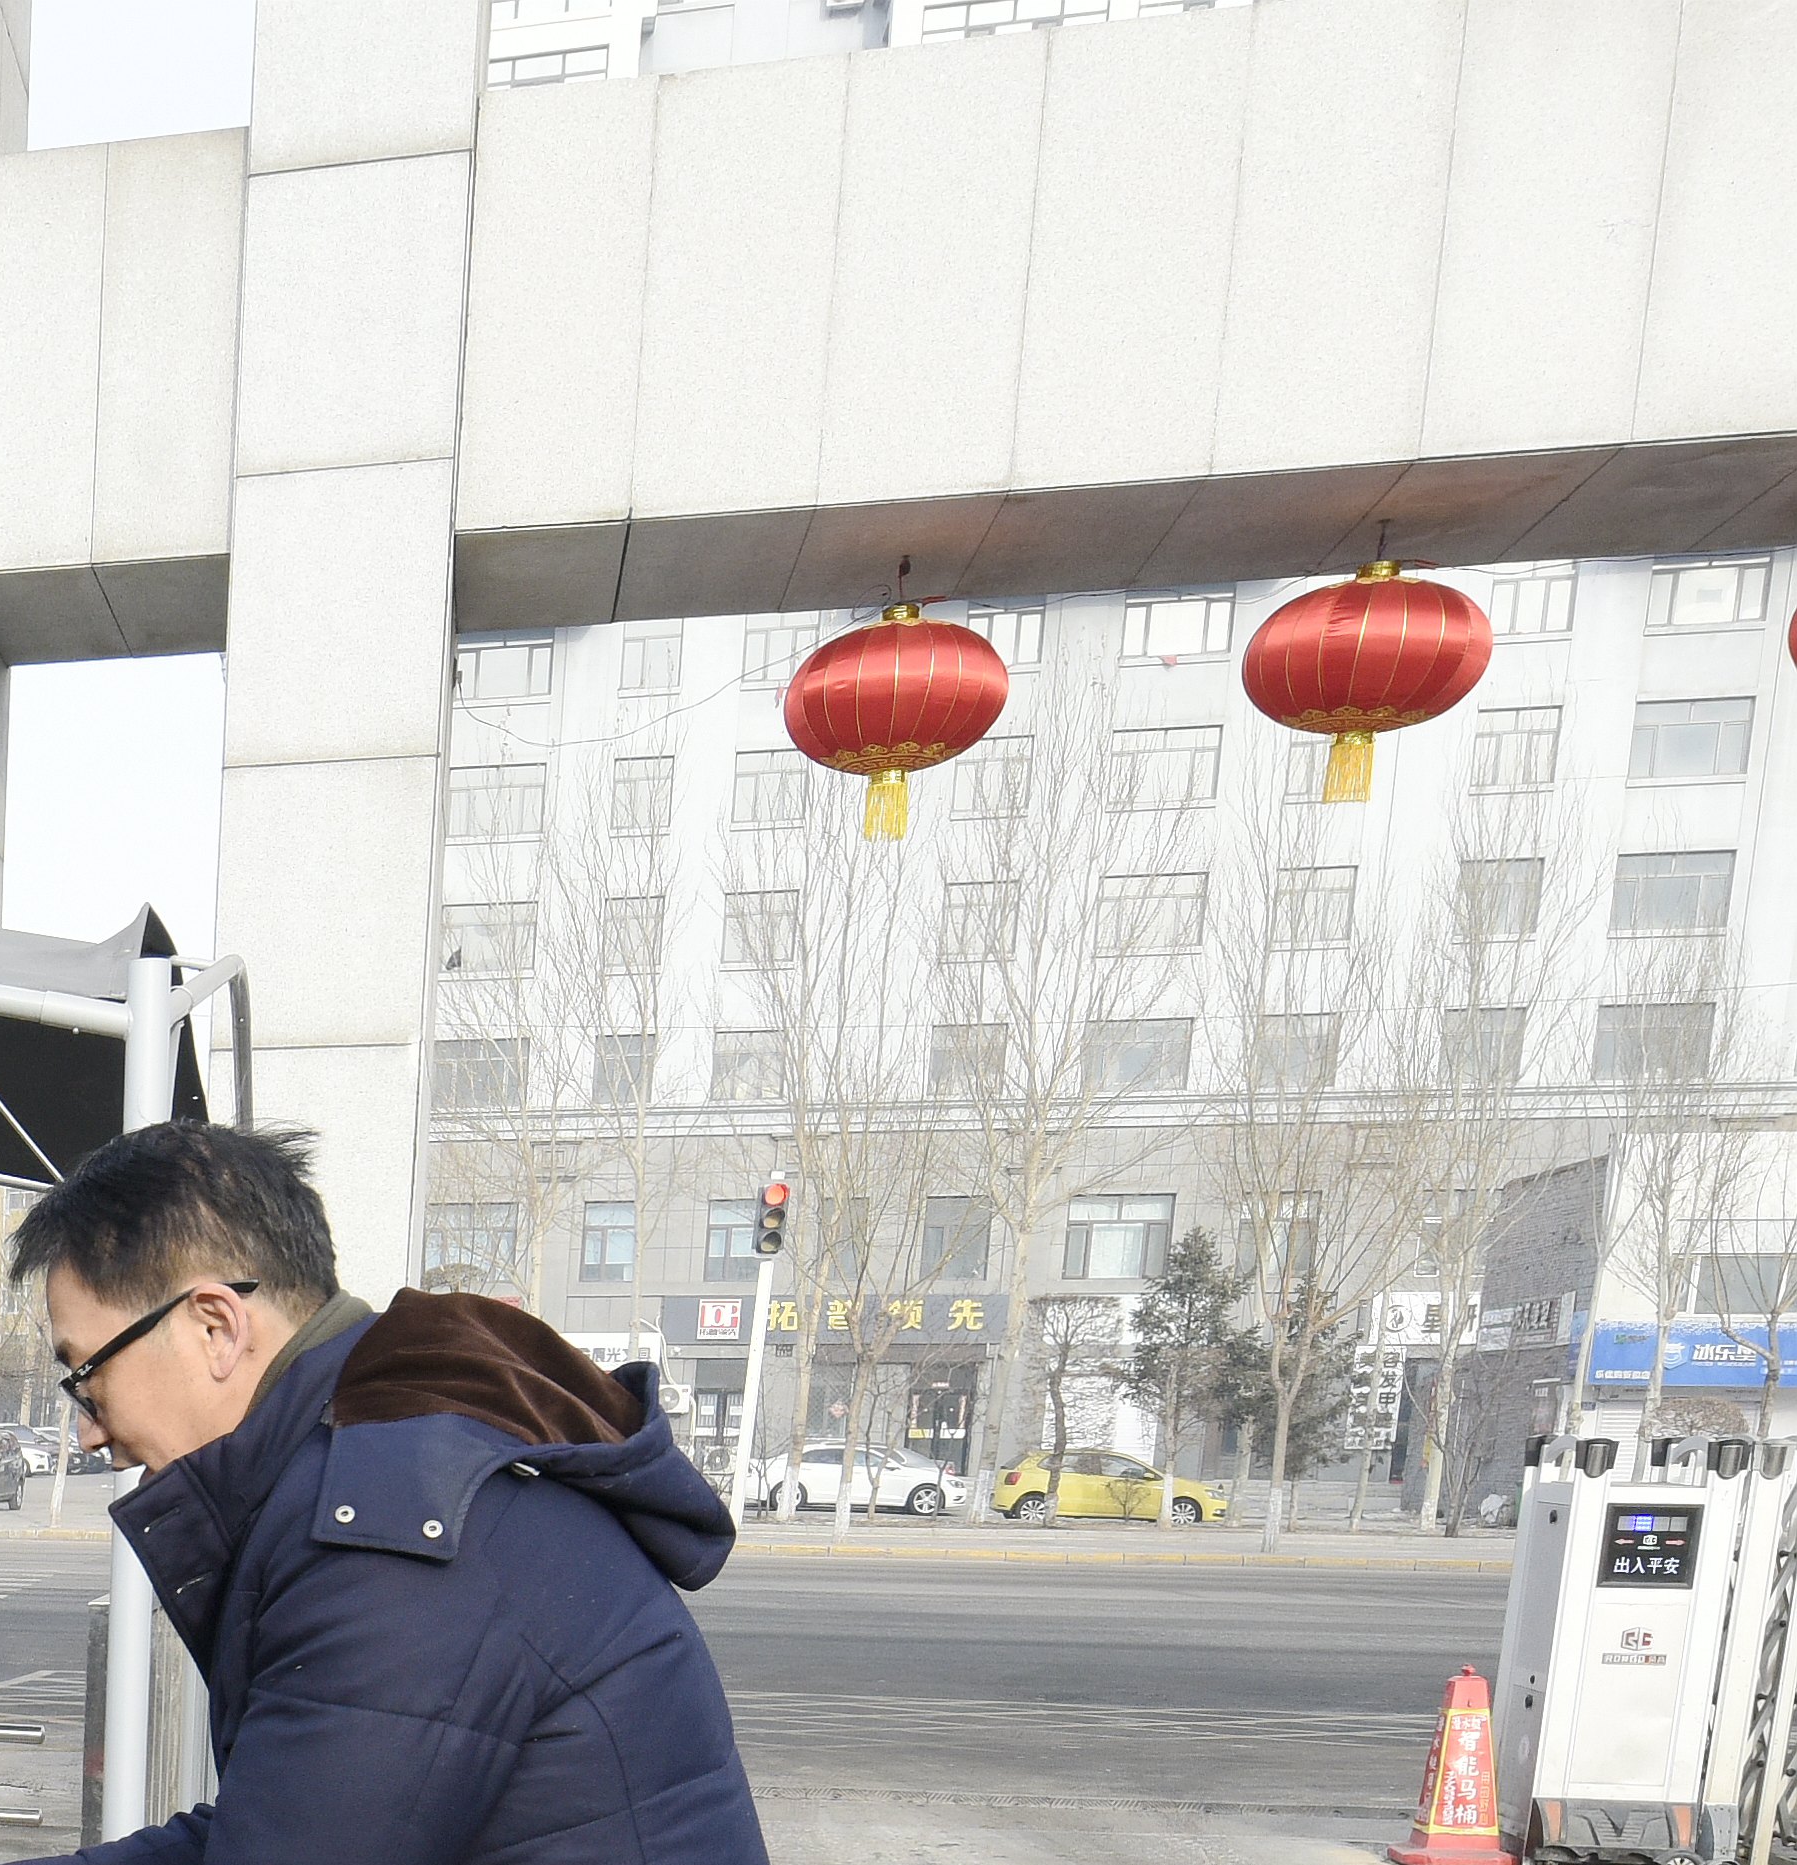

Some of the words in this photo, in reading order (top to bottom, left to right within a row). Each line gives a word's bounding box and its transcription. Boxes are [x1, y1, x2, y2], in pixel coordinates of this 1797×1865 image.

[767, 1298, 985, 1331] 拓普领先
[1613, 1556, 1680, 1575] 出入平安
[1454, 1731, 1480, 1826] 智能马桶
